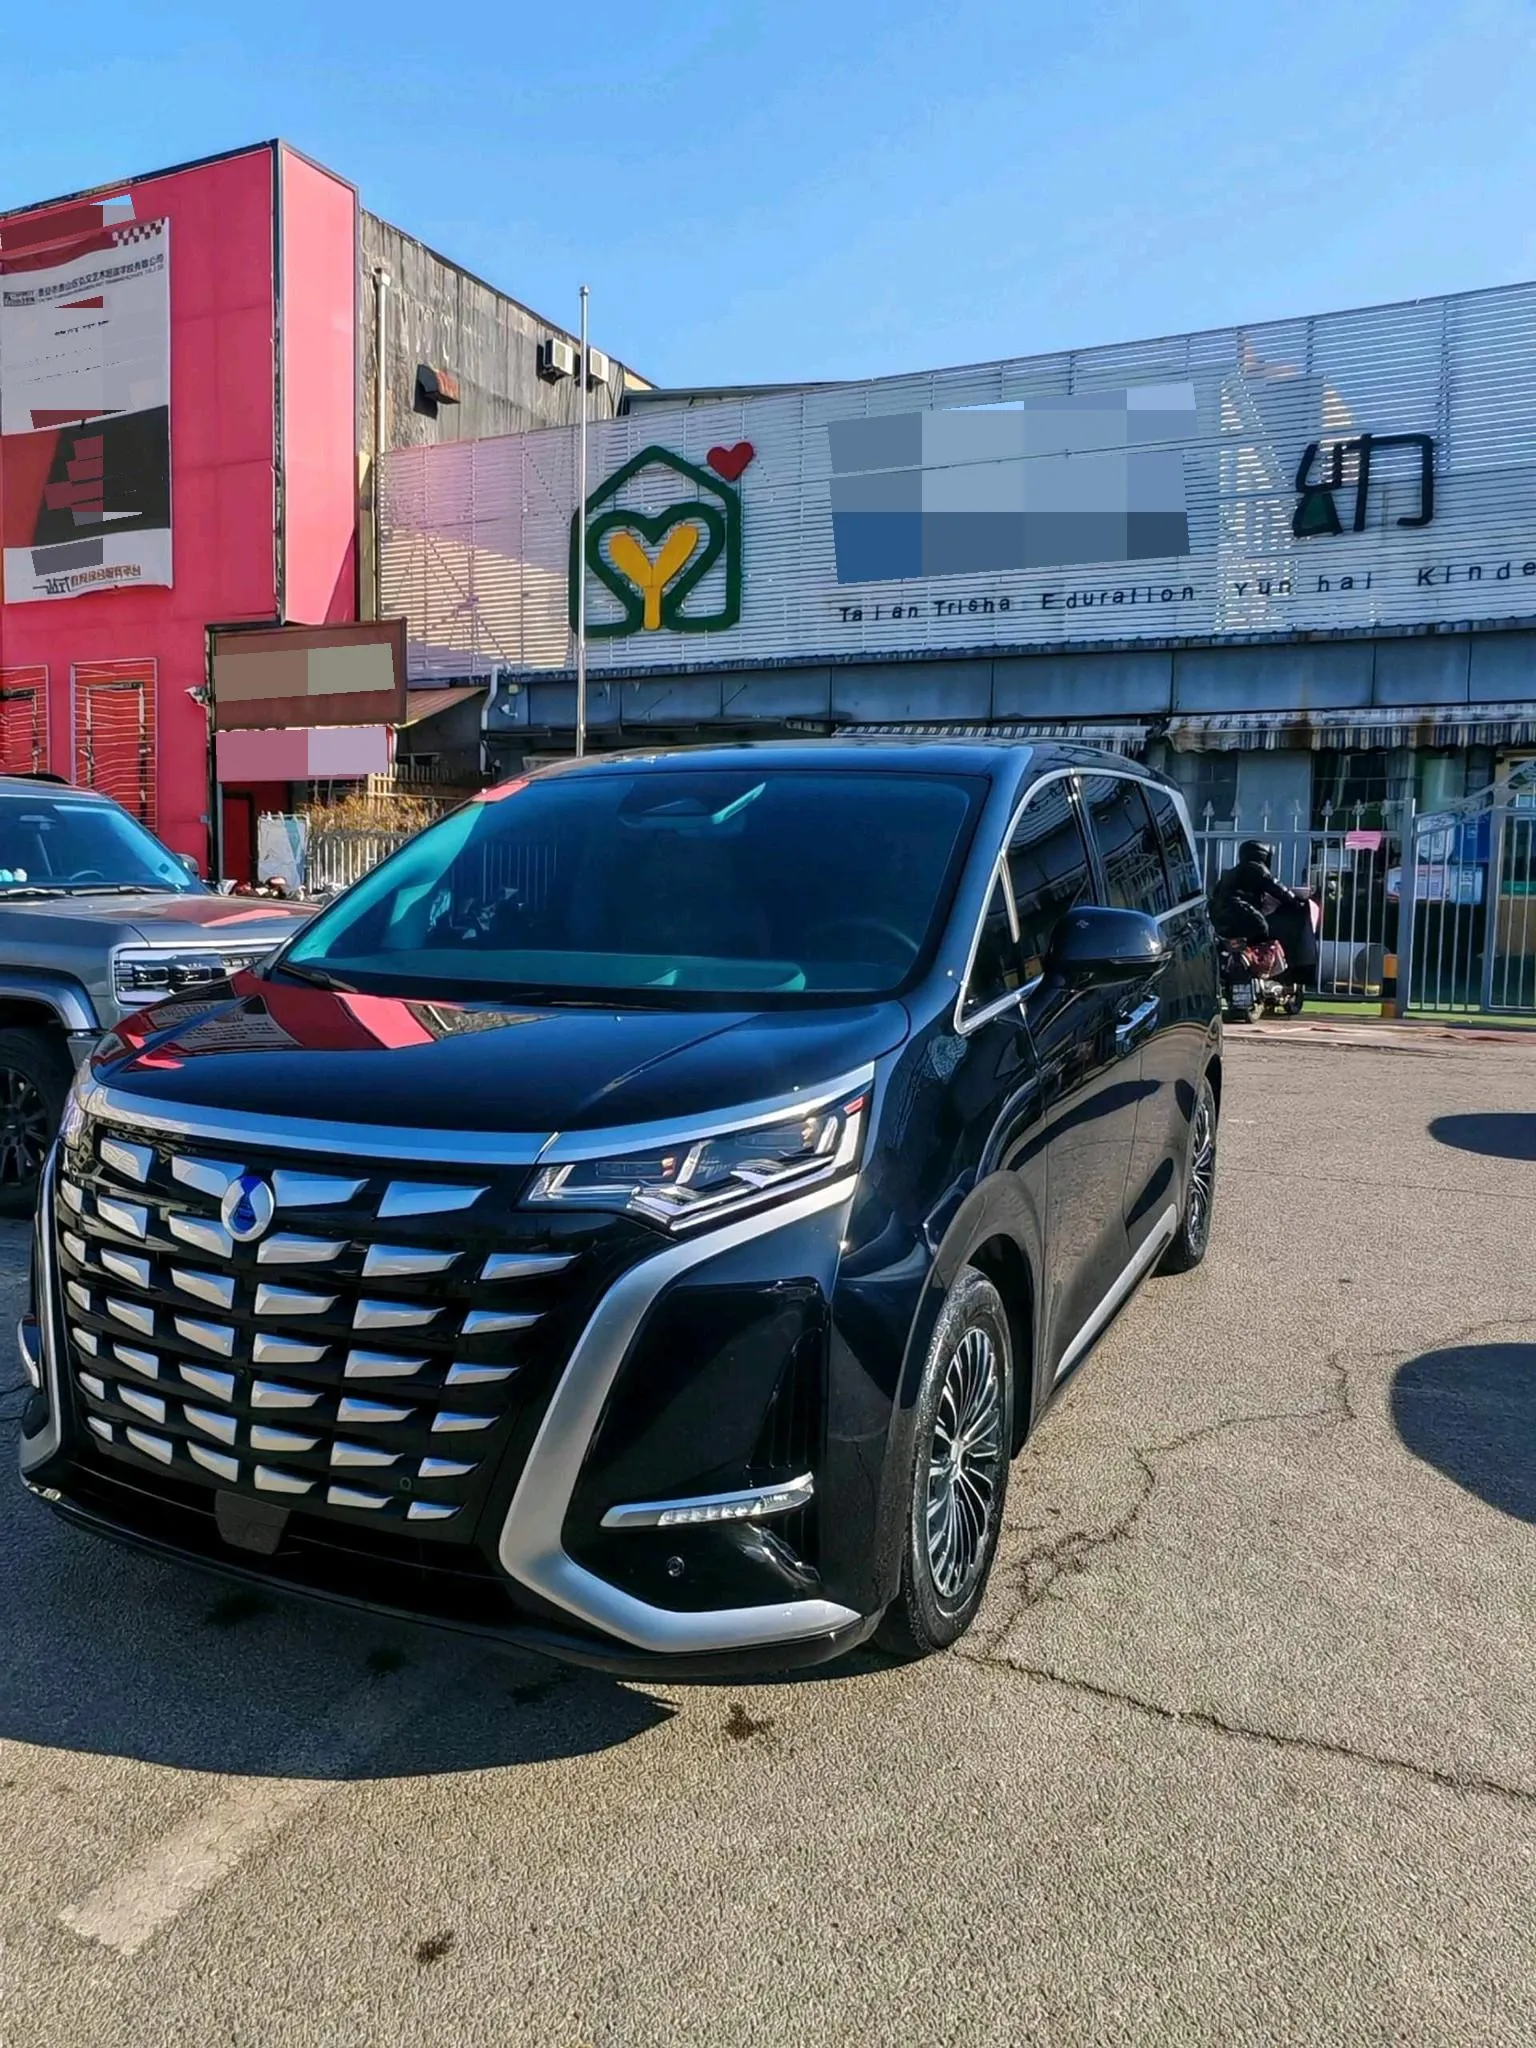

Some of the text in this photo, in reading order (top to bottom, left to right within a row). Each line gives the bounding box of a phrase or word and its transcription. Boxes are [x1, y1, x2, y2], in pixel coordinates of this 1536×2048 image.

[933, 597, 1010, 617] Trisha
[1317, 572, 1372, 592] hai
[1417, 561, 1536, 586] Kinde
